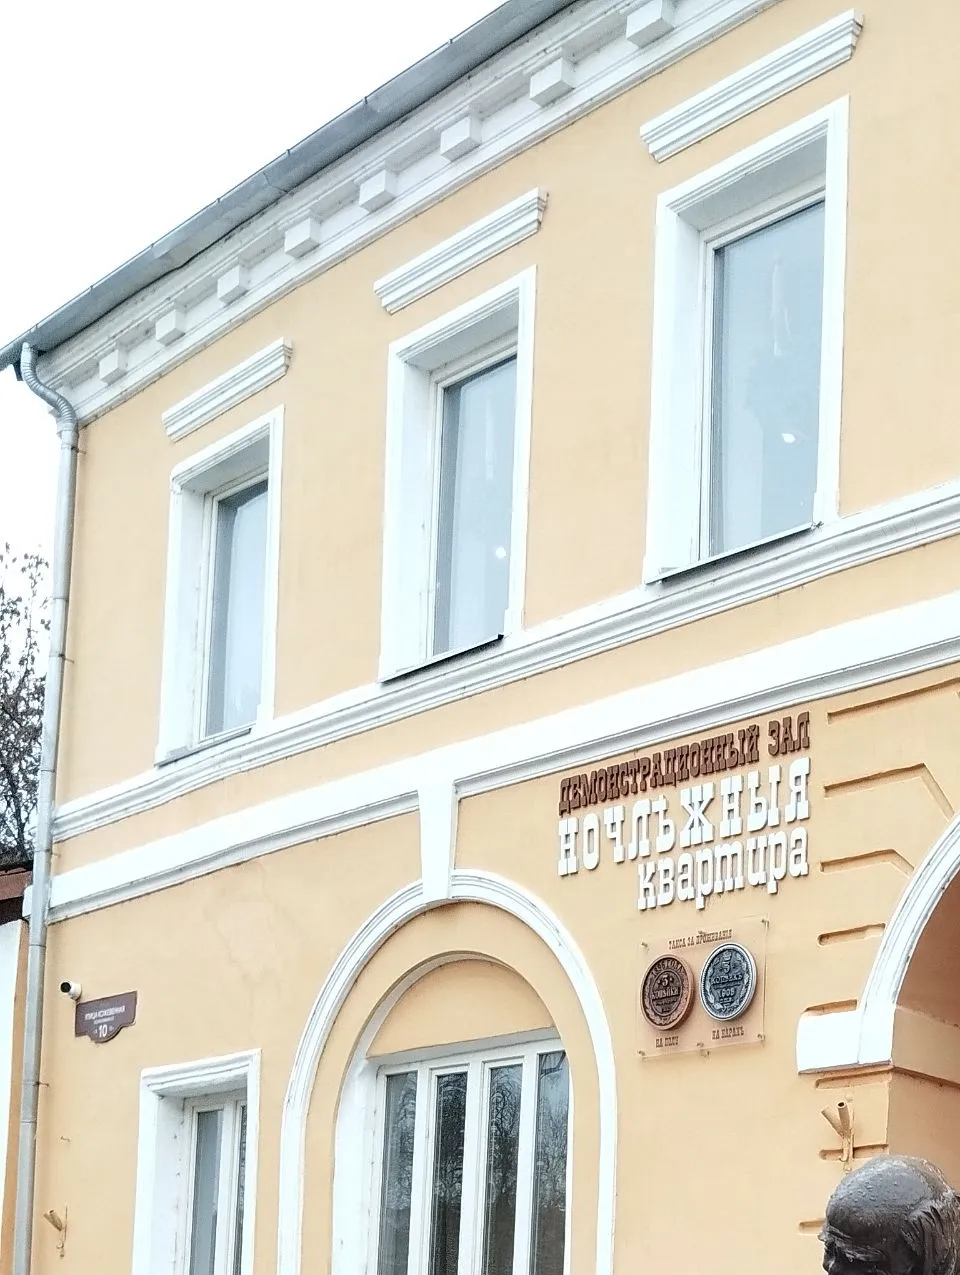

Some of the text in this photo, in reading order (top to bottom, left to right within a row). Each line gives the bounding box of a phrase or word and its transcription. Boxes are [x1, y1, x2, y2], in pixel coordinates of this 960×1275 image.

[558, 711, 810, 816] ДЕМОНСТРАЦИОННЫЙ ЗАЛ
[637, 827, 809, 910] квартира
